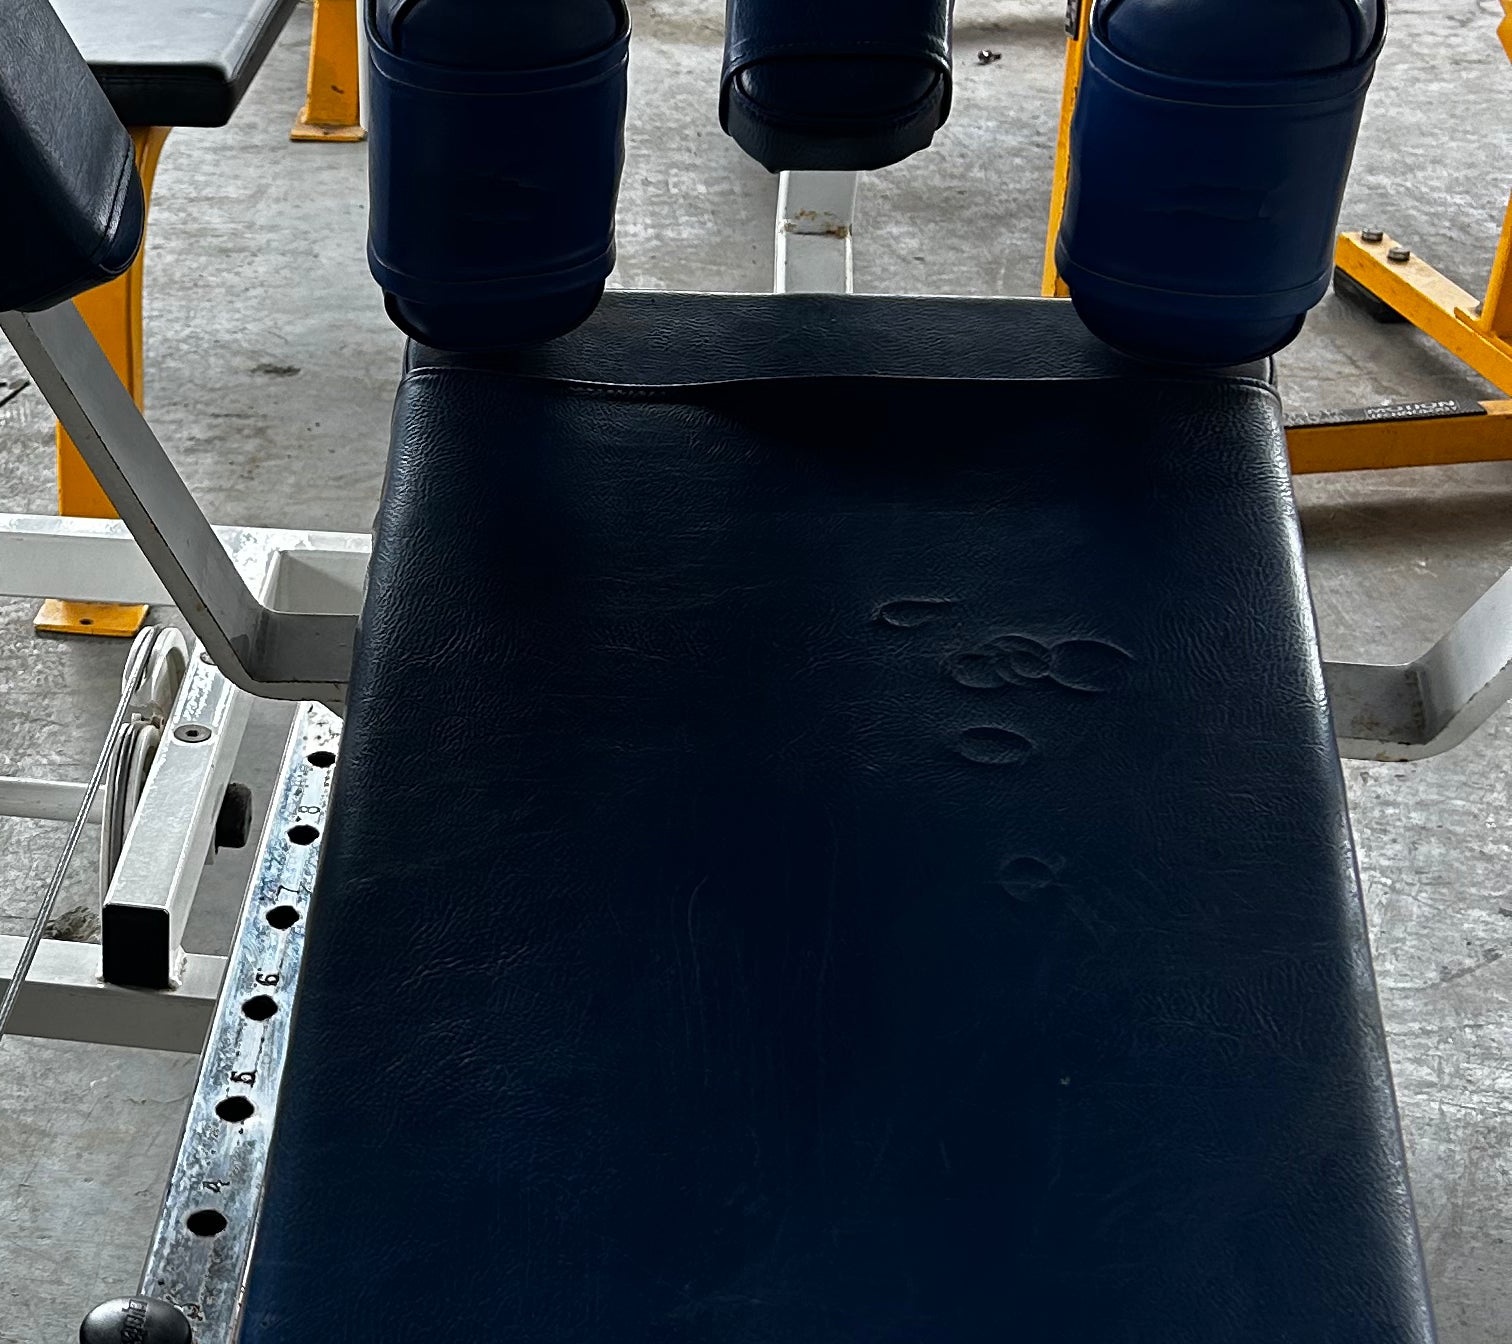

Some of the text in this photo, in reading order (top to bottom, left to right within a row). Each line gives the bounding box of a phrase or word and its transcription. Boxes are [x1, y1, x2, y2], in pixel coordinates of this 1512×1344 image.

[298, 805, 321, 815] 8
[276, 885, 300, 899] 7
[255, 971, 279, 986] 6
[230, 1070, 257, 1088] 5
[203, 1180, 230, 1193] 4
